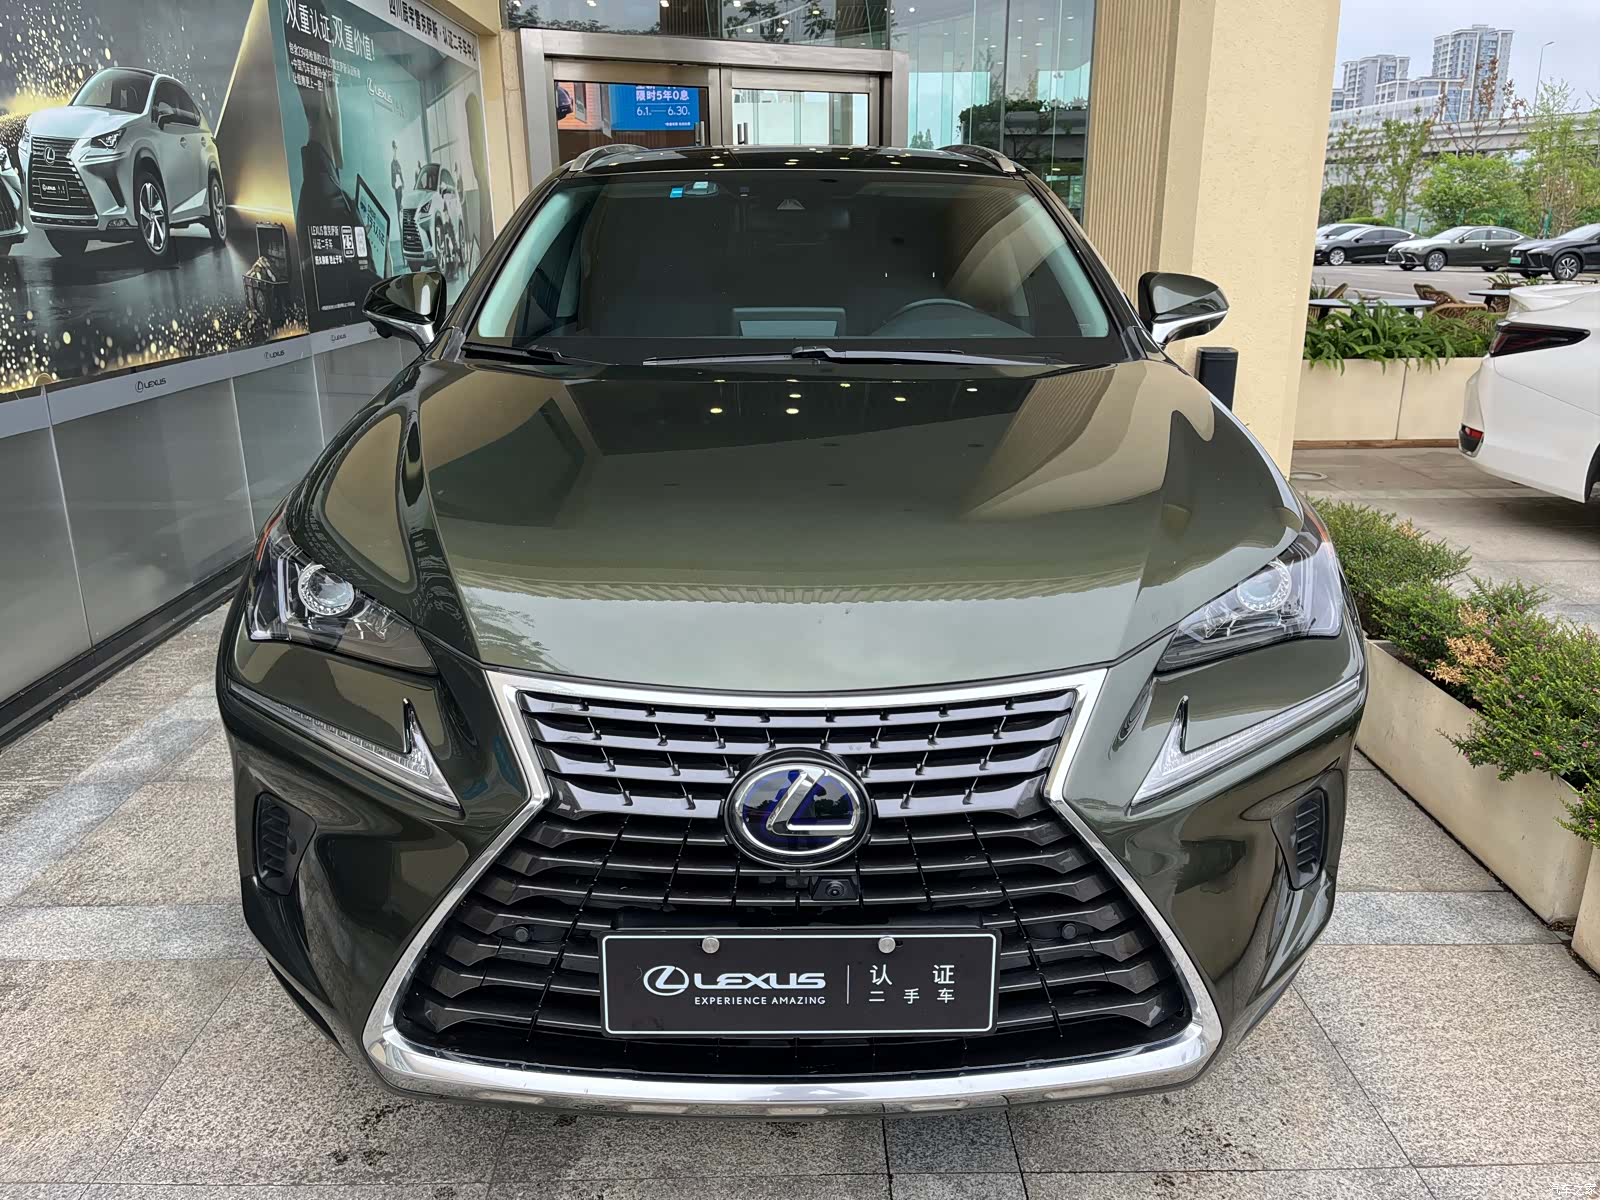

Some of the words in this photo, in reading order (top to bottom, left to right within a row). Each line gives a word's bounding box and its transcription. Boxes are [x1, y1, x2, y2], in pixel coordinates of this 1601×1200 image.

[636, 90, 690, 101] 限时5年0息
[312, 238, 333, 250] 认证二手车
[144, 378, 167, 389] LEXUS
[694, 972, 826, 990] LEXUS
[869, 964, 955, 986] 认证
[694, 996, 767, 1005] EXPERIENCE
[771, 996, 826, 1005] AMAZING
[868, 987, 955, 1004] 二手车
